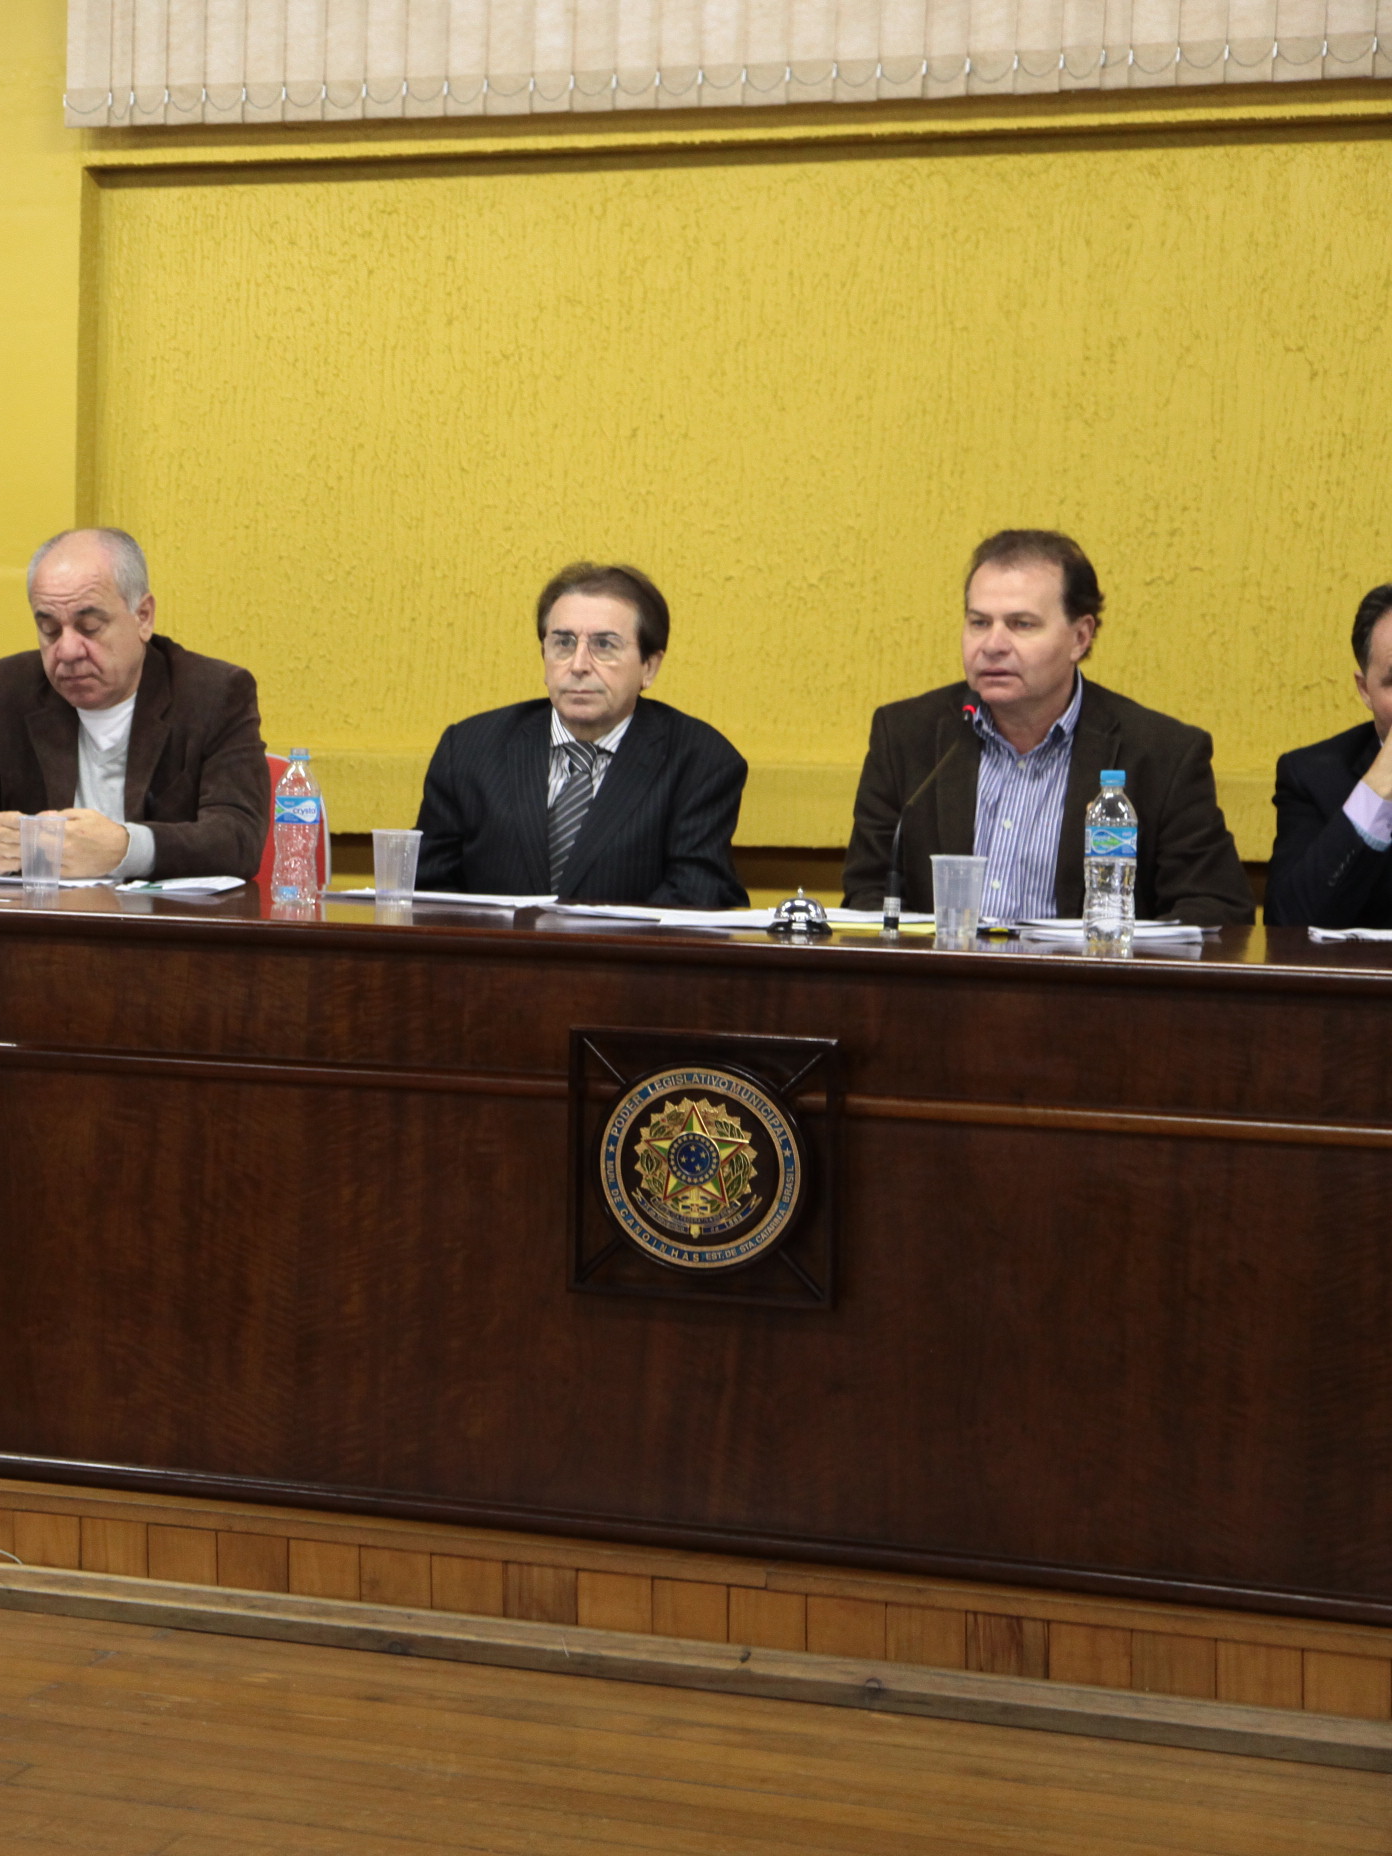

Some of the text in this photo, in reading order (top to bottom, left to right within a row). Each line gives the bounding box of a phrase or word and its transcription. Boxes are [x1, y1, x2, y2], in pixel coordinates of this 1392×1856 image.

[611, 1074, 788, 1144] PODER LEGISLATIVO MUNICIPAL
[611, 1188, 622, 1203] DE
[620, 1209, 700, 1262] CANOINHAS
[782, 1165, 795, 1204] BRASIL
